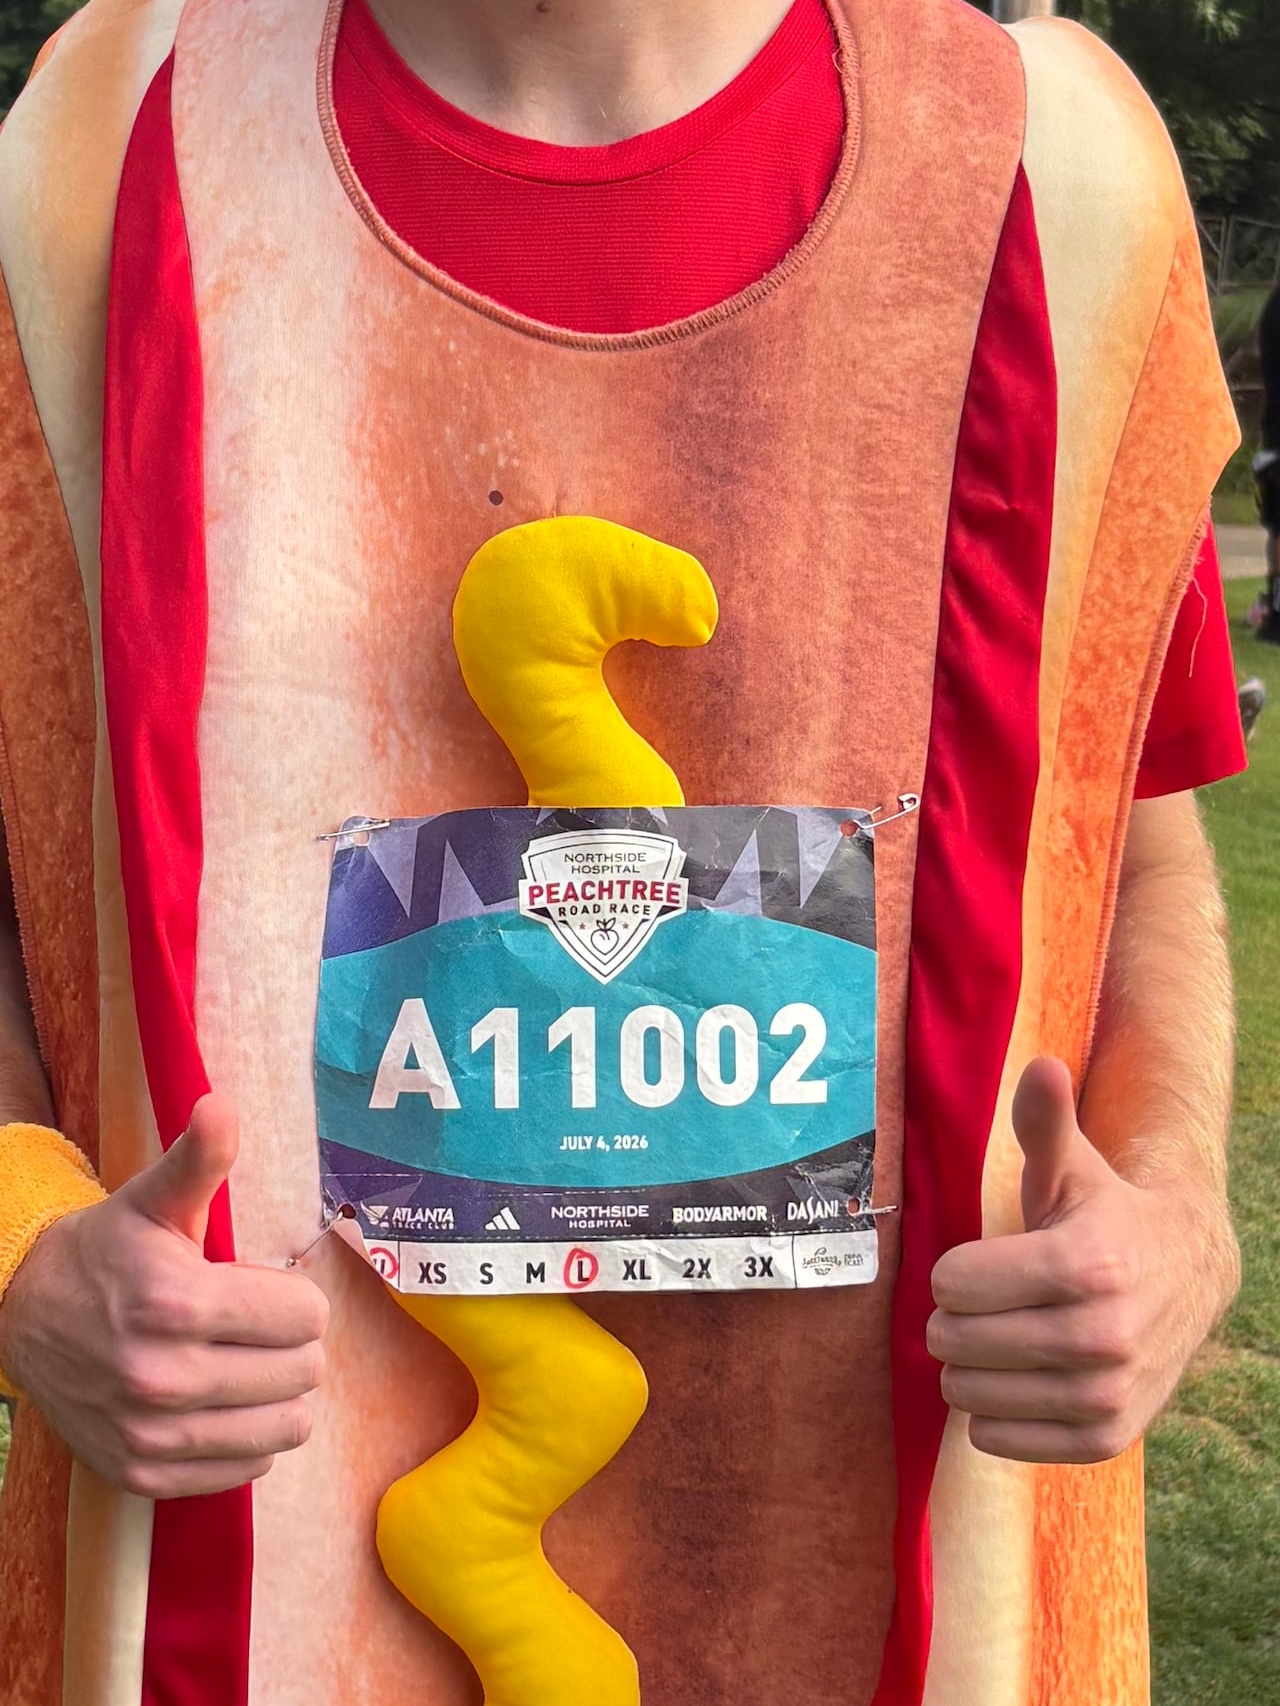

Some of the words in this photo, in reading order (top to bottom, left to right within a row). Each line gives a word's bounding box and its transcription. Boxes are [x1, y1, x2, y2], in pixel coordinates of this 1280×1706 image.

[564, 852, 647, 863] NORTHSIDE
[571, 864, 641, 875] HOSPITAL
[528, 879, 682, 906] PEACHTREE
[558, 903, 601, 917] ROAD
[609, 903, 651, 916] RACE
[368, 997, 829, 1109] A11002
[559, 1135, 593, 1150] JULY
[596, 1135, 610, 1152] 4,
[613, 1134, 649, 1150] 2026
[392, 1206, 455, 1223] ATLANTA
[551, 1205, 650, 1219] NORTHSIDE
[672, 1204, 768, 1223] BODYARMOR
[786, 1196, 840, 1225] DASANI
[568, 1219, 632, 1229] HOSPITAL
[418, 1261, 447, 1285] XS
[479, 1262, 494, 1285] S
[526, 1261, 545, 1284] M
[577, 1260, 590, 1283] L
[622, 1259, 652, 1281] XL
[682, 1257, 712, 1280] 2X
[743, 1256, 775, 1278] 3X
